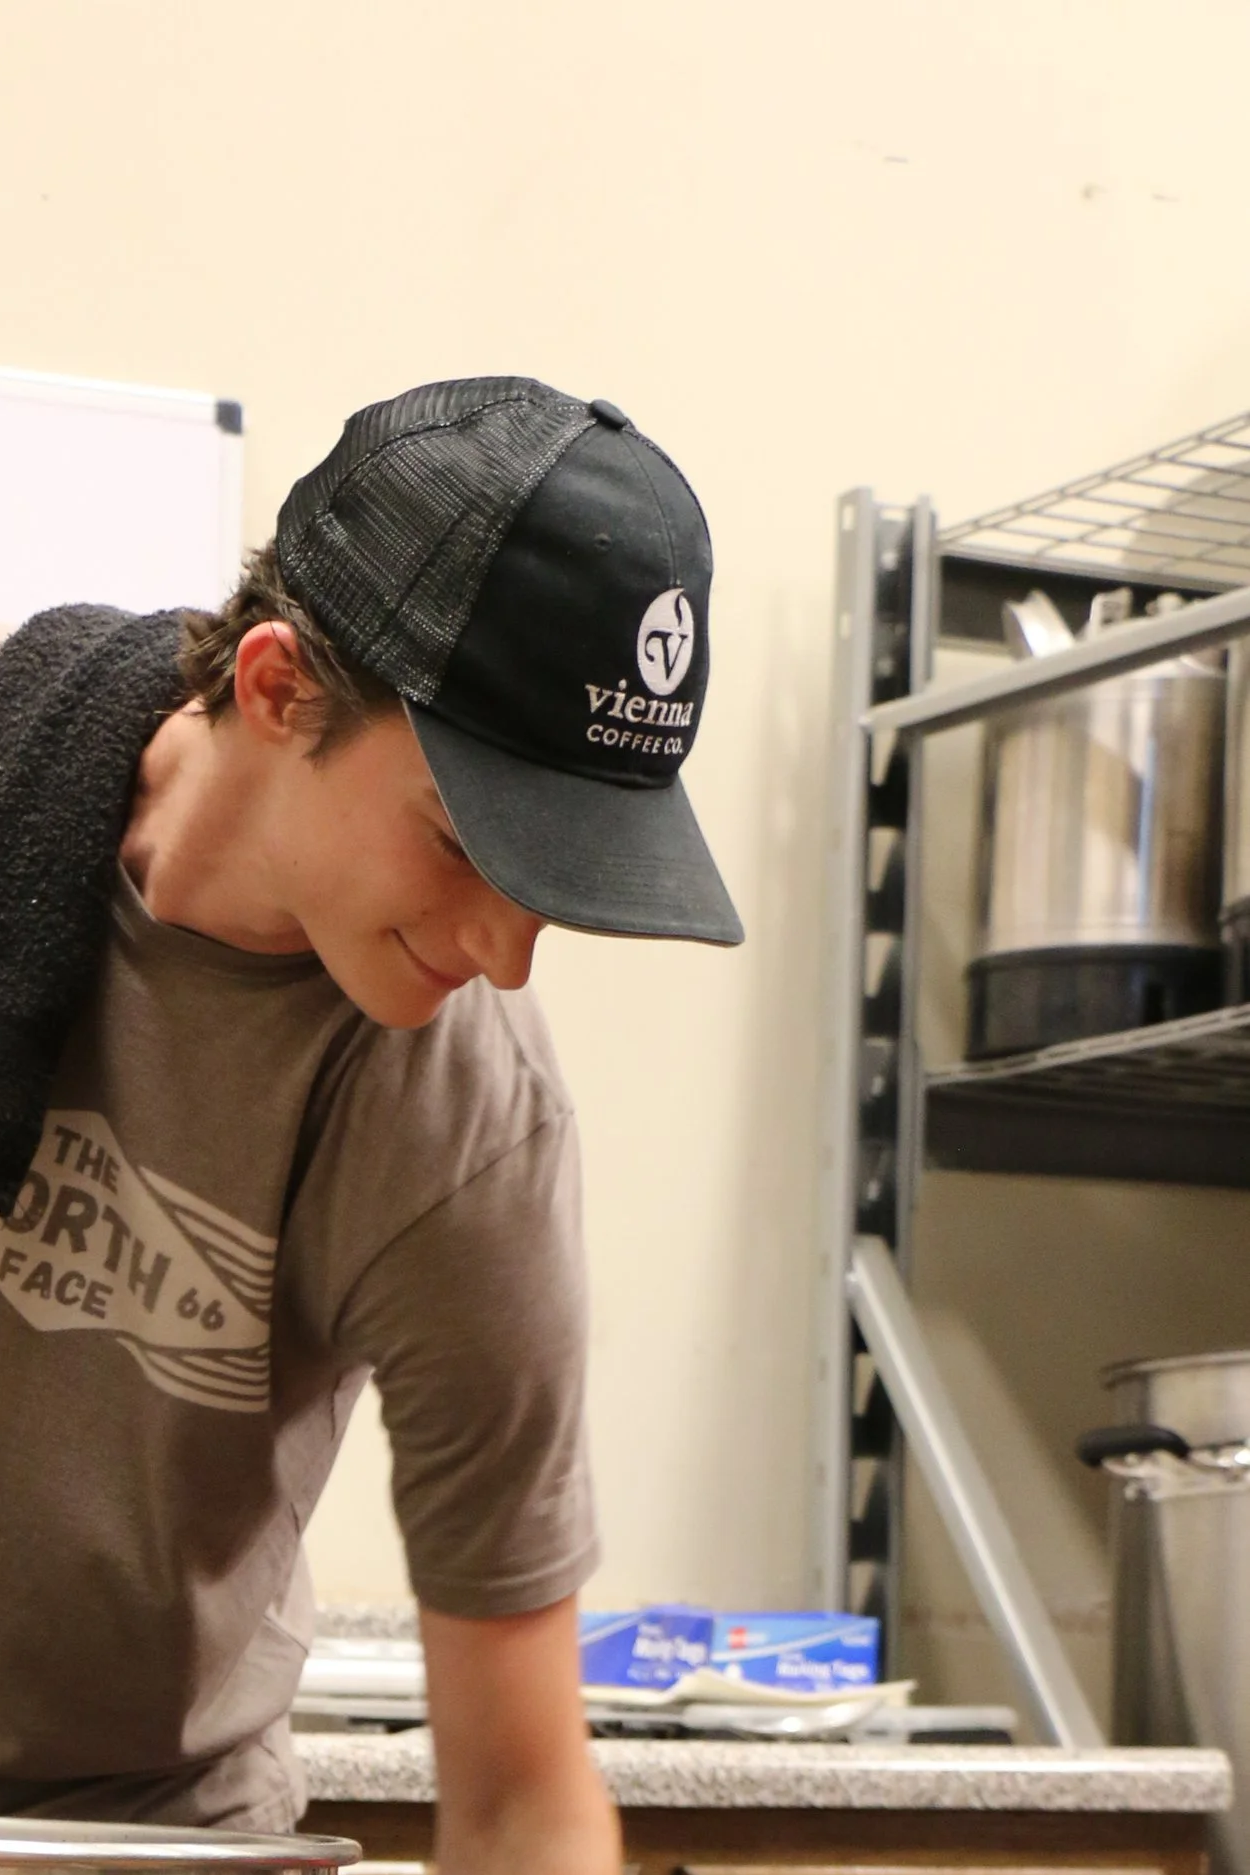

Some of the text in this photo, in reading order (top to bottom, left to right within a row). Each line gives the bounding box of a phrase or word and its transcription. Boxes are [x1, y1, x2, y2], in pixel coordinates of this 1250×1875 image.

[584, 678, 694, 728] vienna
[585, 723, 684, 755] COFFEE CO.
[53, 1125, 122, 1195] THE
[3, 1168, 172, 1315] ORTH
[176, 1287, 225, 1331] 66
